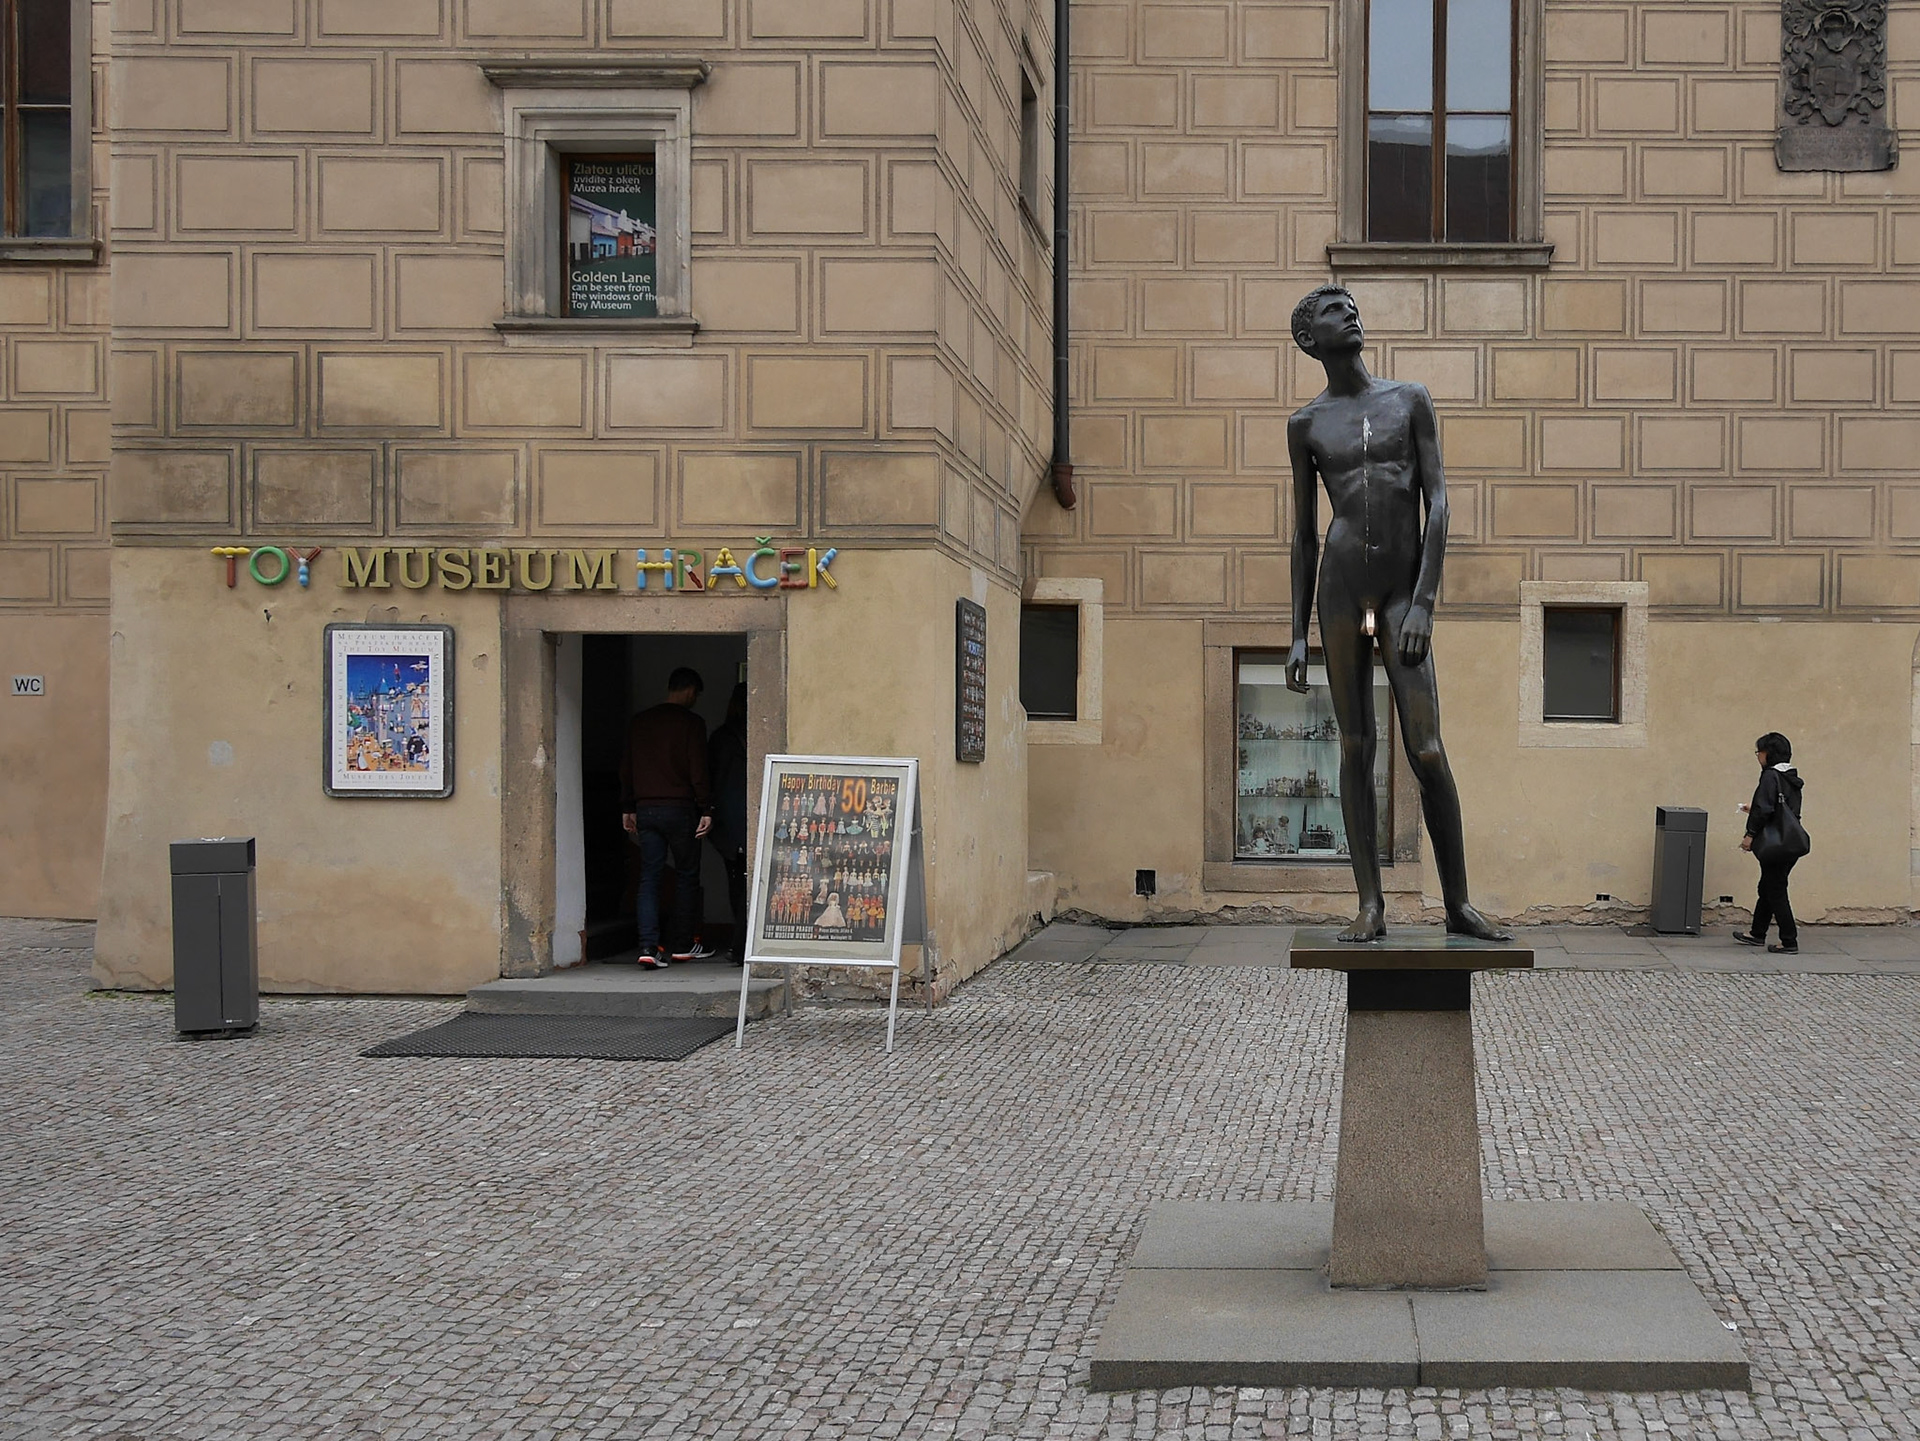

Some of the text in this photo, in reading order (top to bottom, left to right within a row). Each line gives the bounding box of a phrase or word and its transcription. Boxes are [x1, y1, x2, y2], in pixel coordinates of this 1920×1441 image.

[574, 163, 654, 176] Zlatou uličku
[573, 175, 606, 184] uvidíte
[615, 176, 640, 185] oken
[573, 183, 642, 194] Muzea hraček
[571, 271, 651, 284] Golden Lane
[571, 283, 651, 293] can be seen from
[571, 292, 588, 300] the
[589, 292, 631, 301] windows
[632, 292, 644, 301] of
[571, 300, 632, 311] Toy Museum
[211, 536, 838, 592] TOY MUSEUM HRAČEK
[15, 678, 40, 692] WC
[781, 773, 896, 814] Happy Birthday 50 Barbie
